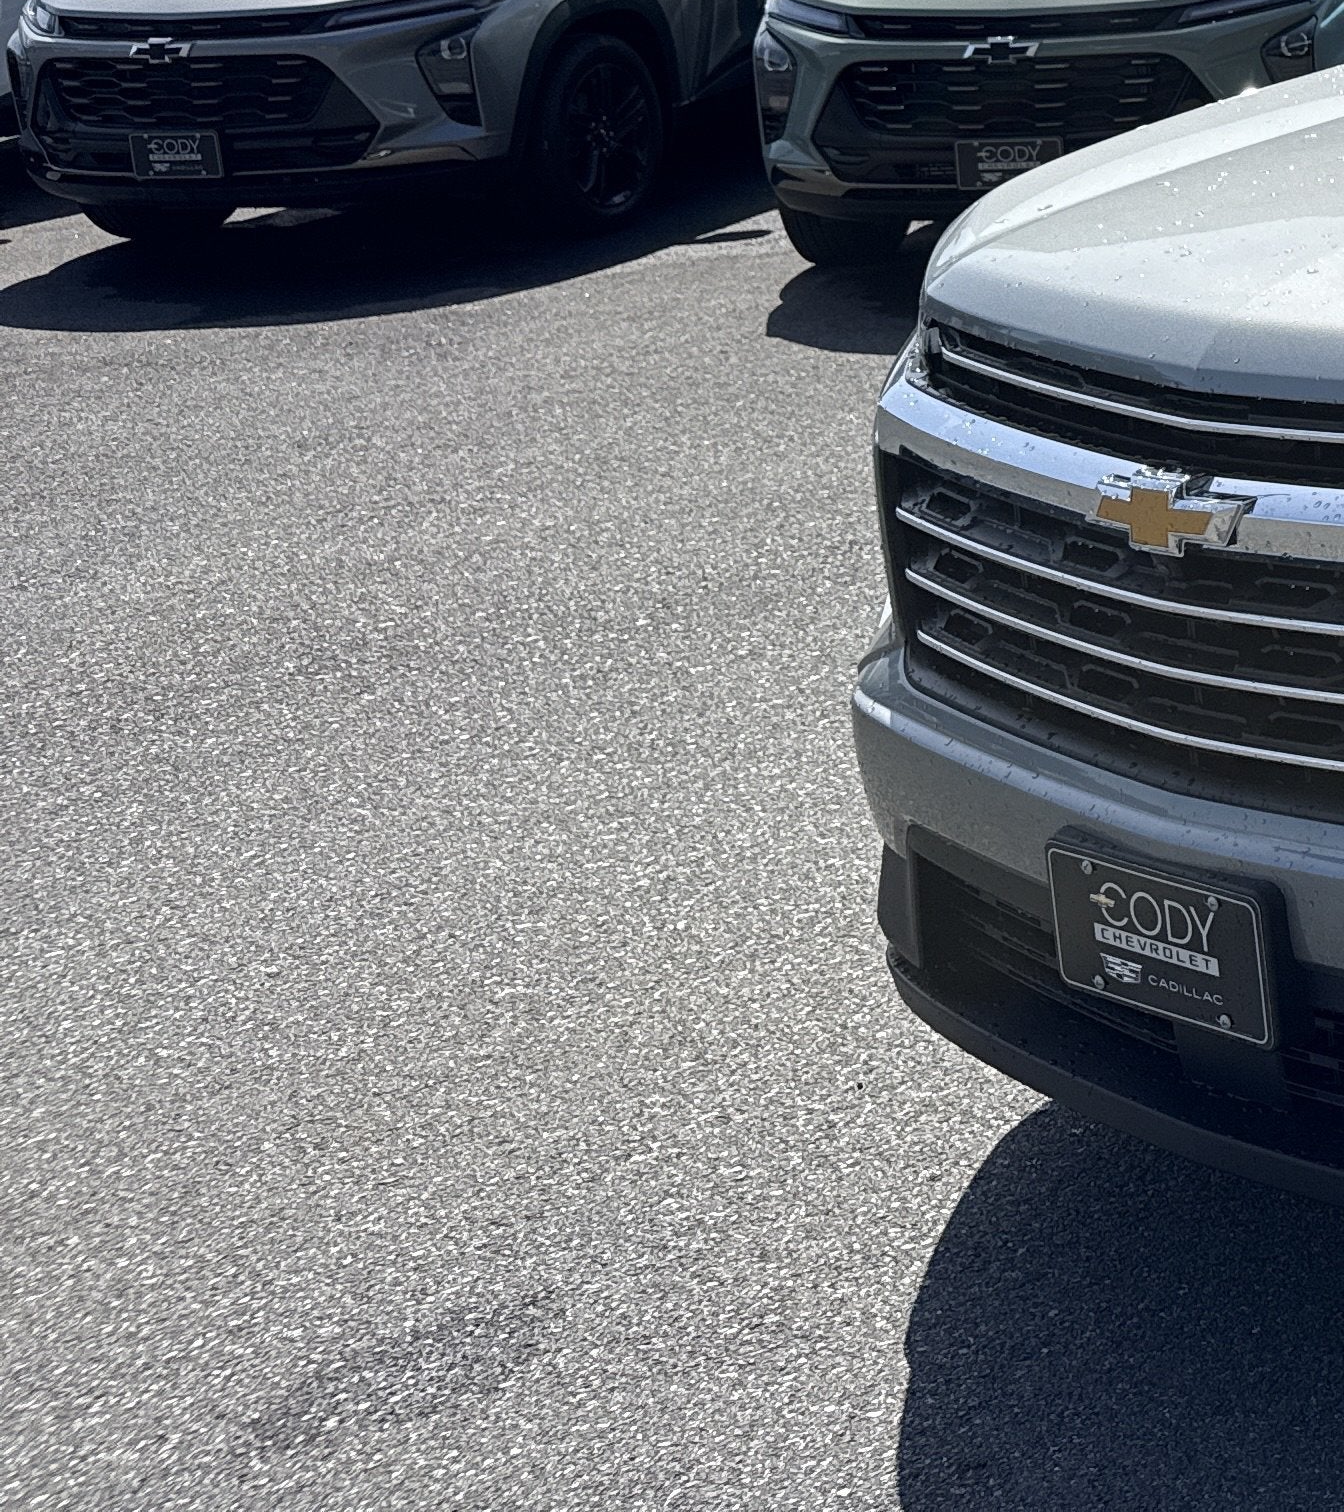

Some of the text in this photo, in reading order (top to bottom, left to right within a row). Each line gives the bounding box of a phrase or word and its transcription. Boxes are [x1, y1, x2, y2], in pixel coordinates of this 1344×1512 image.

[983, 146, 1040, 161] CODY
[1100, 882, 1214, 952] CODY
[1100, 928, 1212, 971] CHEVROLET
[1148, 975, 1223, 1005] CADILLAC
